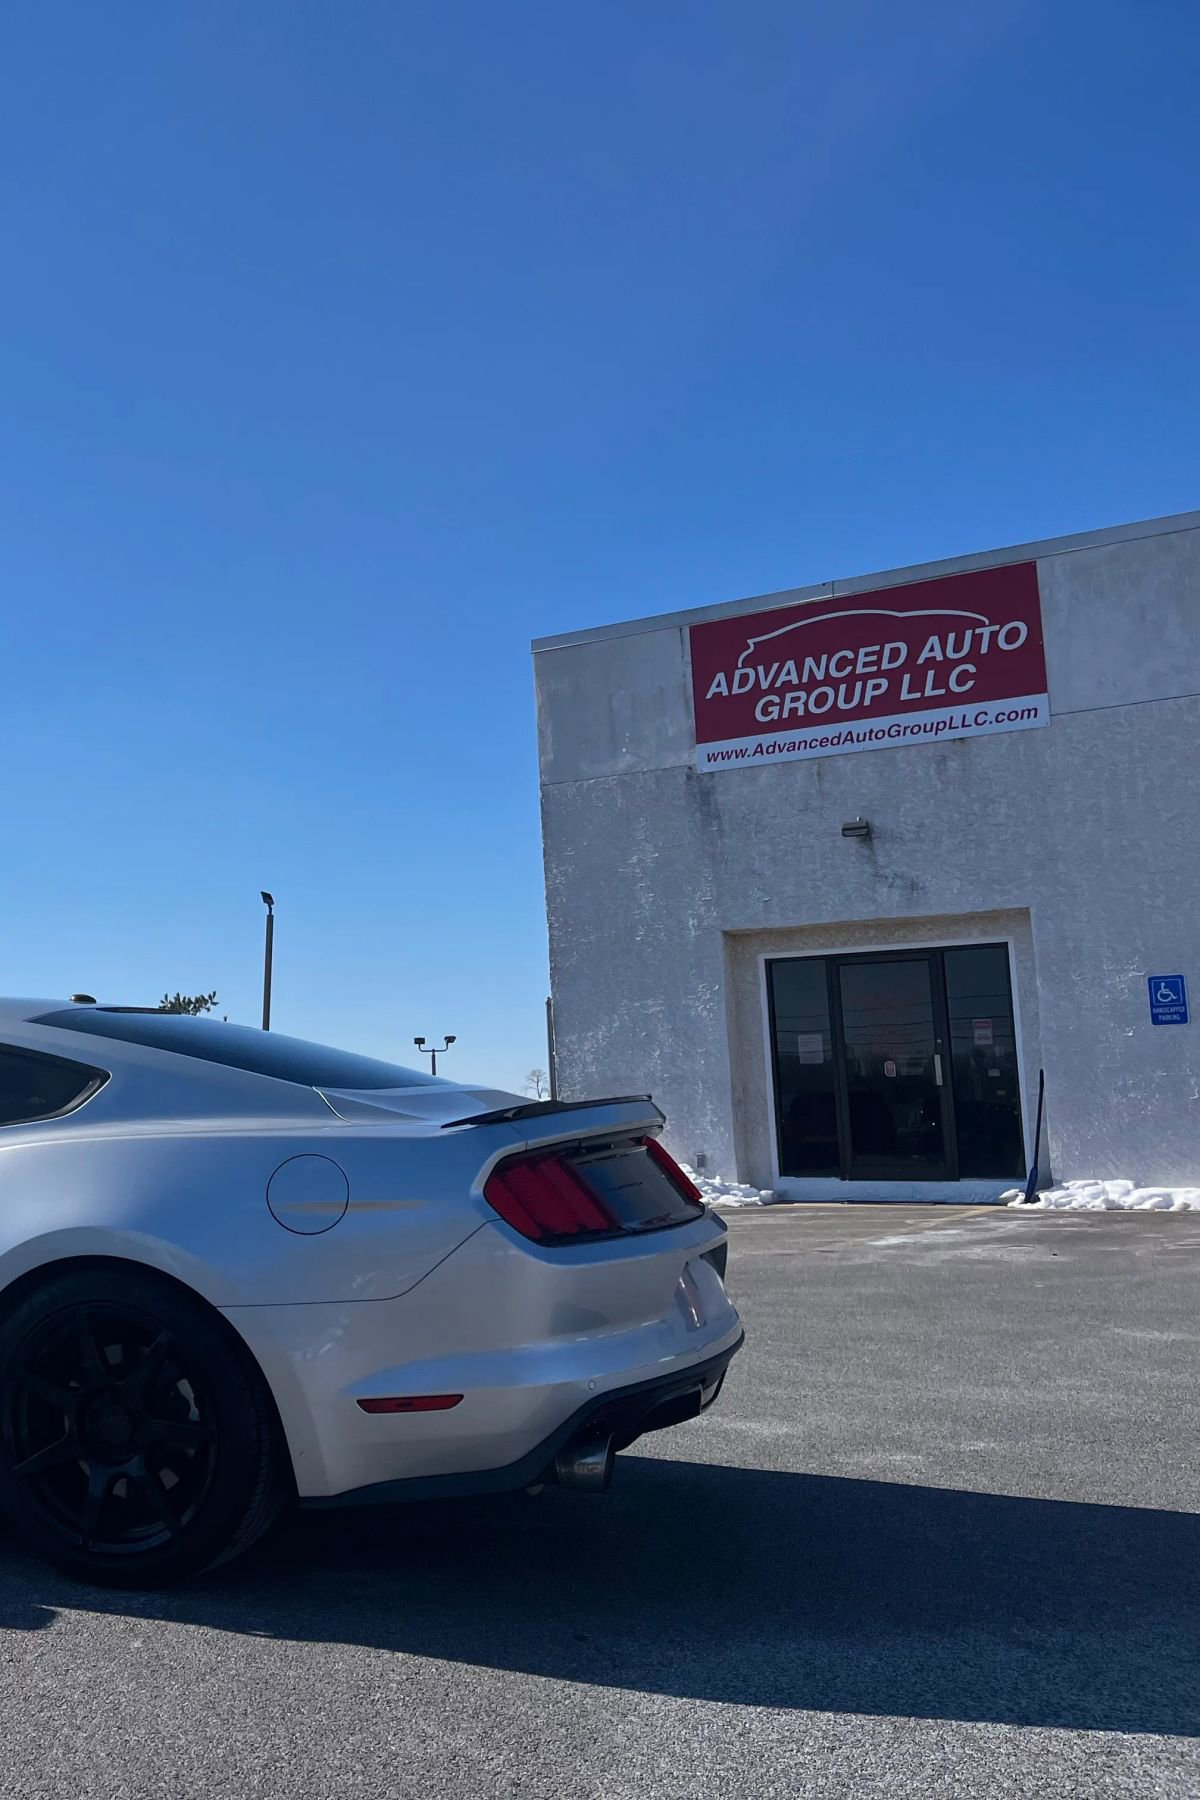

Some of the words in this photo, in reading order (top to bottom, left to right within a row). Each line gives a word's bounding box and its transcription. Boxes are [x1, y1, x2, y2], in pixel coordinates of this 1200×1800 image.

[705, 641, 908, 700] ADVANCED
[916, 621, 1028, 665] AUTO
[754, 677, 889, 723] GROUP
[900, 663, 977, 701] LLC
[707, 707, 1039, 763] www.AdvancedAutoGroupLLC.com
